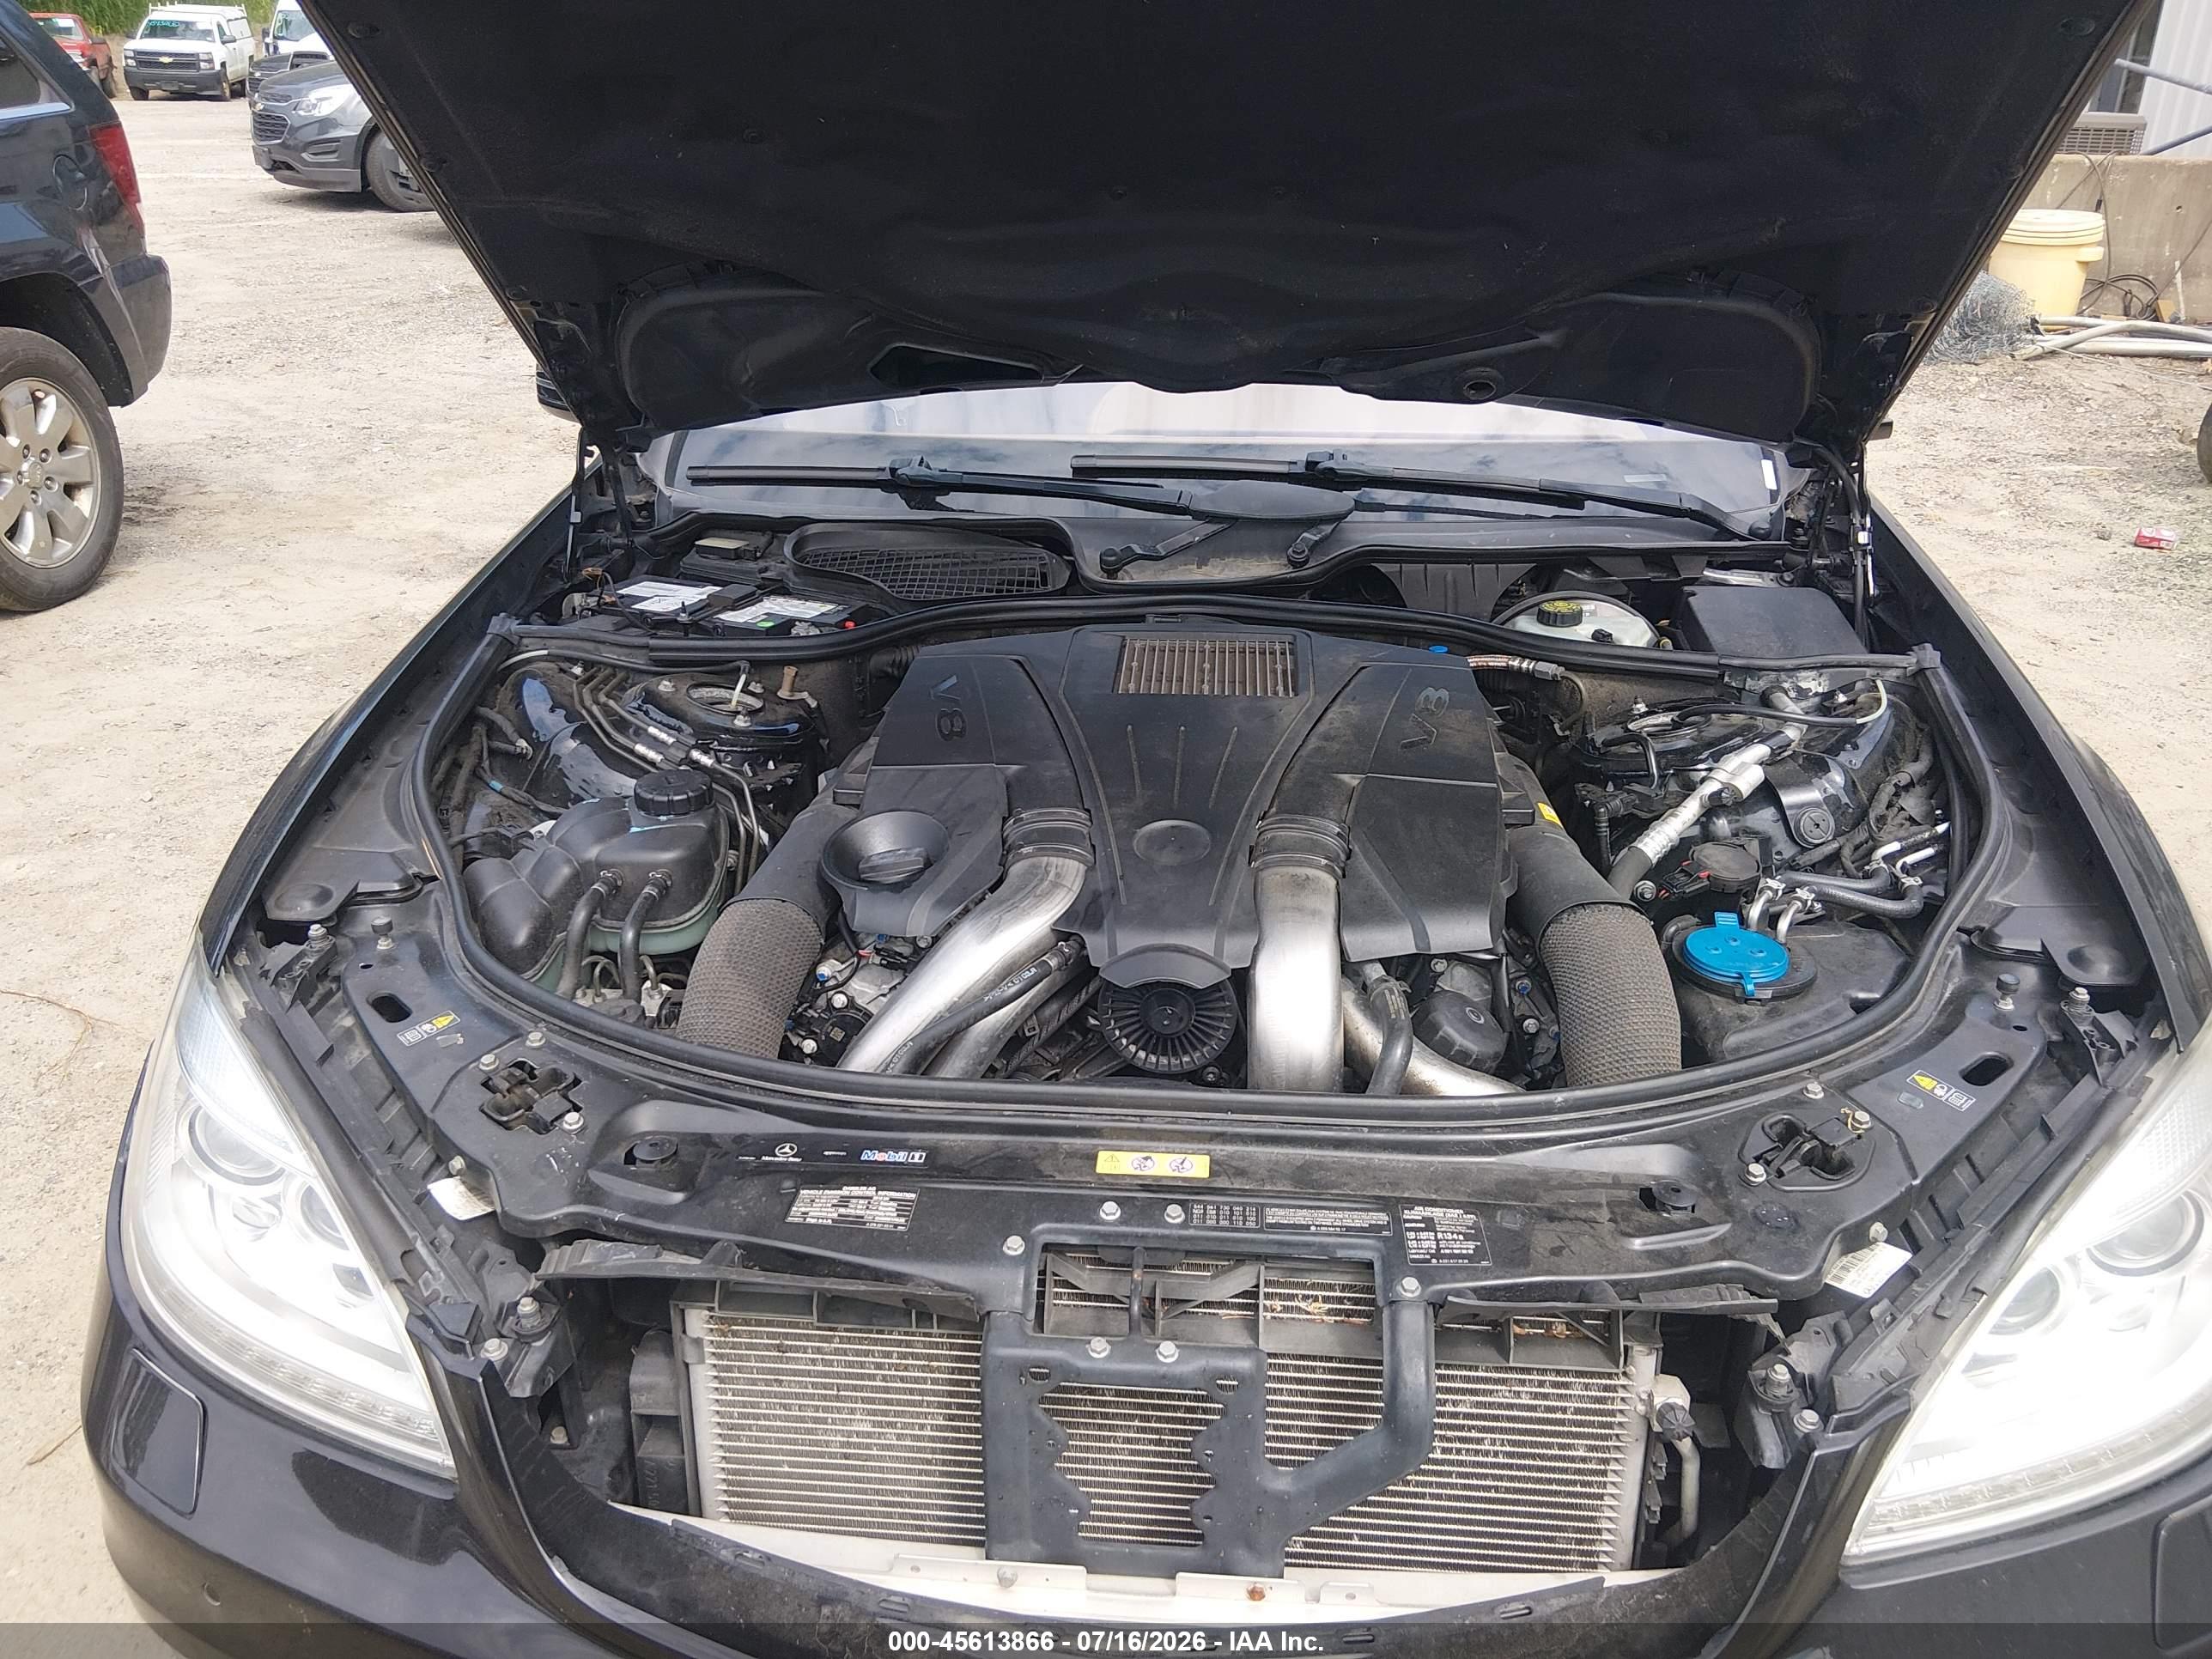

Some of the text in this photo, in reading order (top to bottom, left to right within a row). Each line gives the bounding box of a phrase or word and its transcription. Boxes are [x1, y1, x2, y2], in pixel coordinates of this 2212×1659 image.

[930, 674, 968, 741] V8
[1400, 686, 1449, 750] V8
[860, 1150, 908, 1162] Mobil
